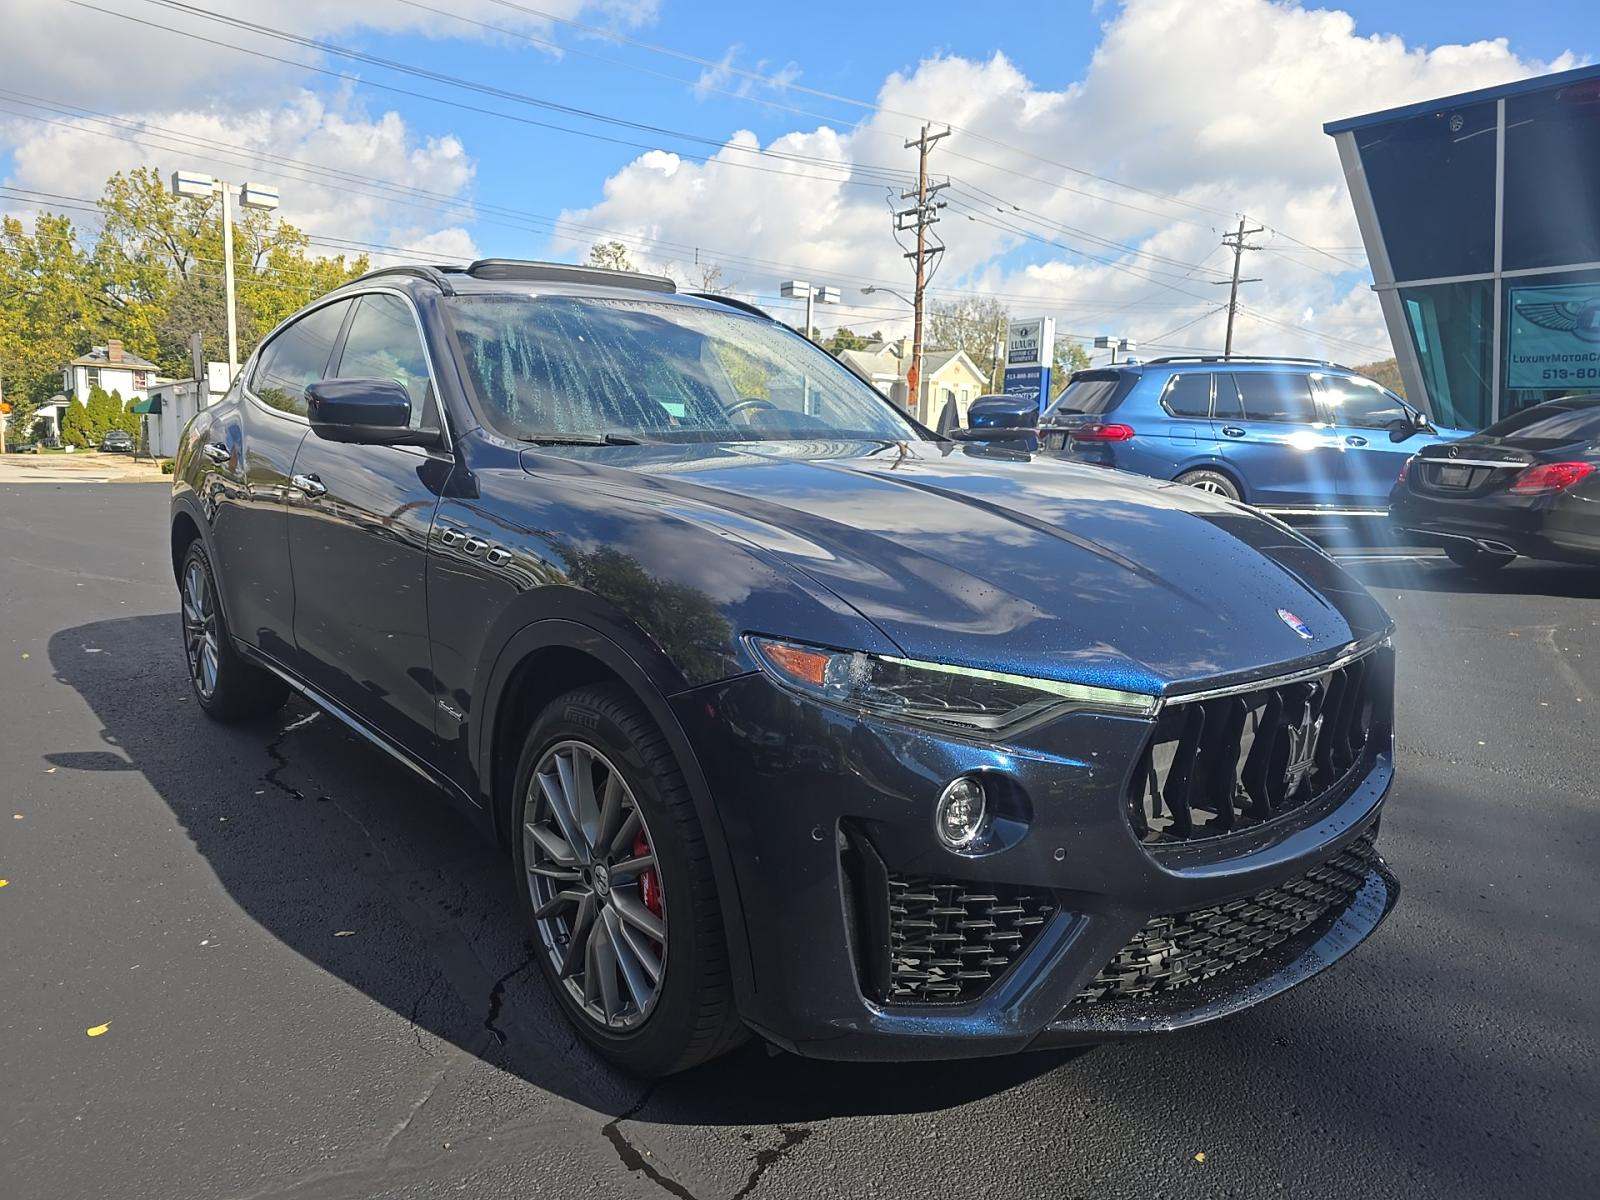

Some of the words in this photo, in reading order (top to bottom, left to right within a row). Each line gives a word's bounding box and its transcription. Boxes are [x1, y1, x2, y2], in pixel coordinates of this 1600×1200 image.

[1011, 340, 1036, 349] LUXURY
[1513, 352, 1600, 364] LUXURYMOTORC
[1542, 368, 1600, 380] 513-80
